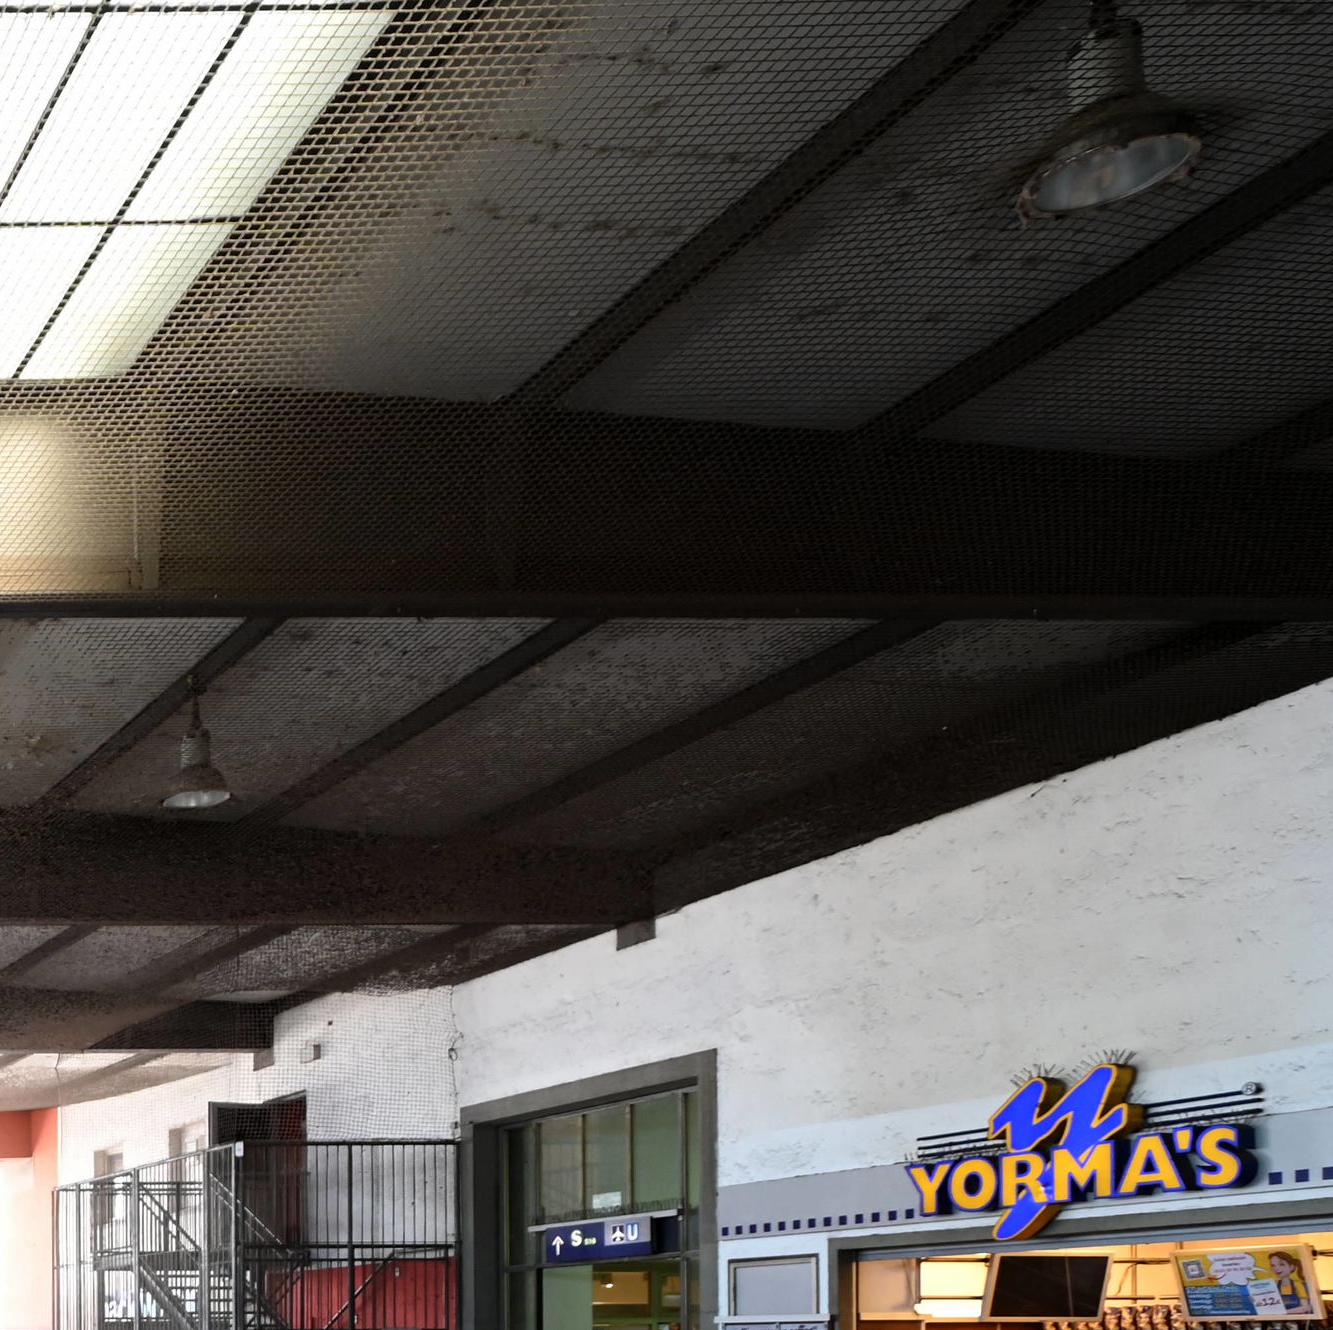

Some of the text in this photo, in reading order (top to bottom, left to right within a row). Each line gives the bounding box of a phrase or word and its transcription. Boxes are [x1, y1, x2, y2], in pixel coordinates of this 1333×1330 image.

[906, 1123, 1241, 1217] YORMA'S
[571, 1230, 583, 1247] S
[627, 1223, 638, 1241] U
